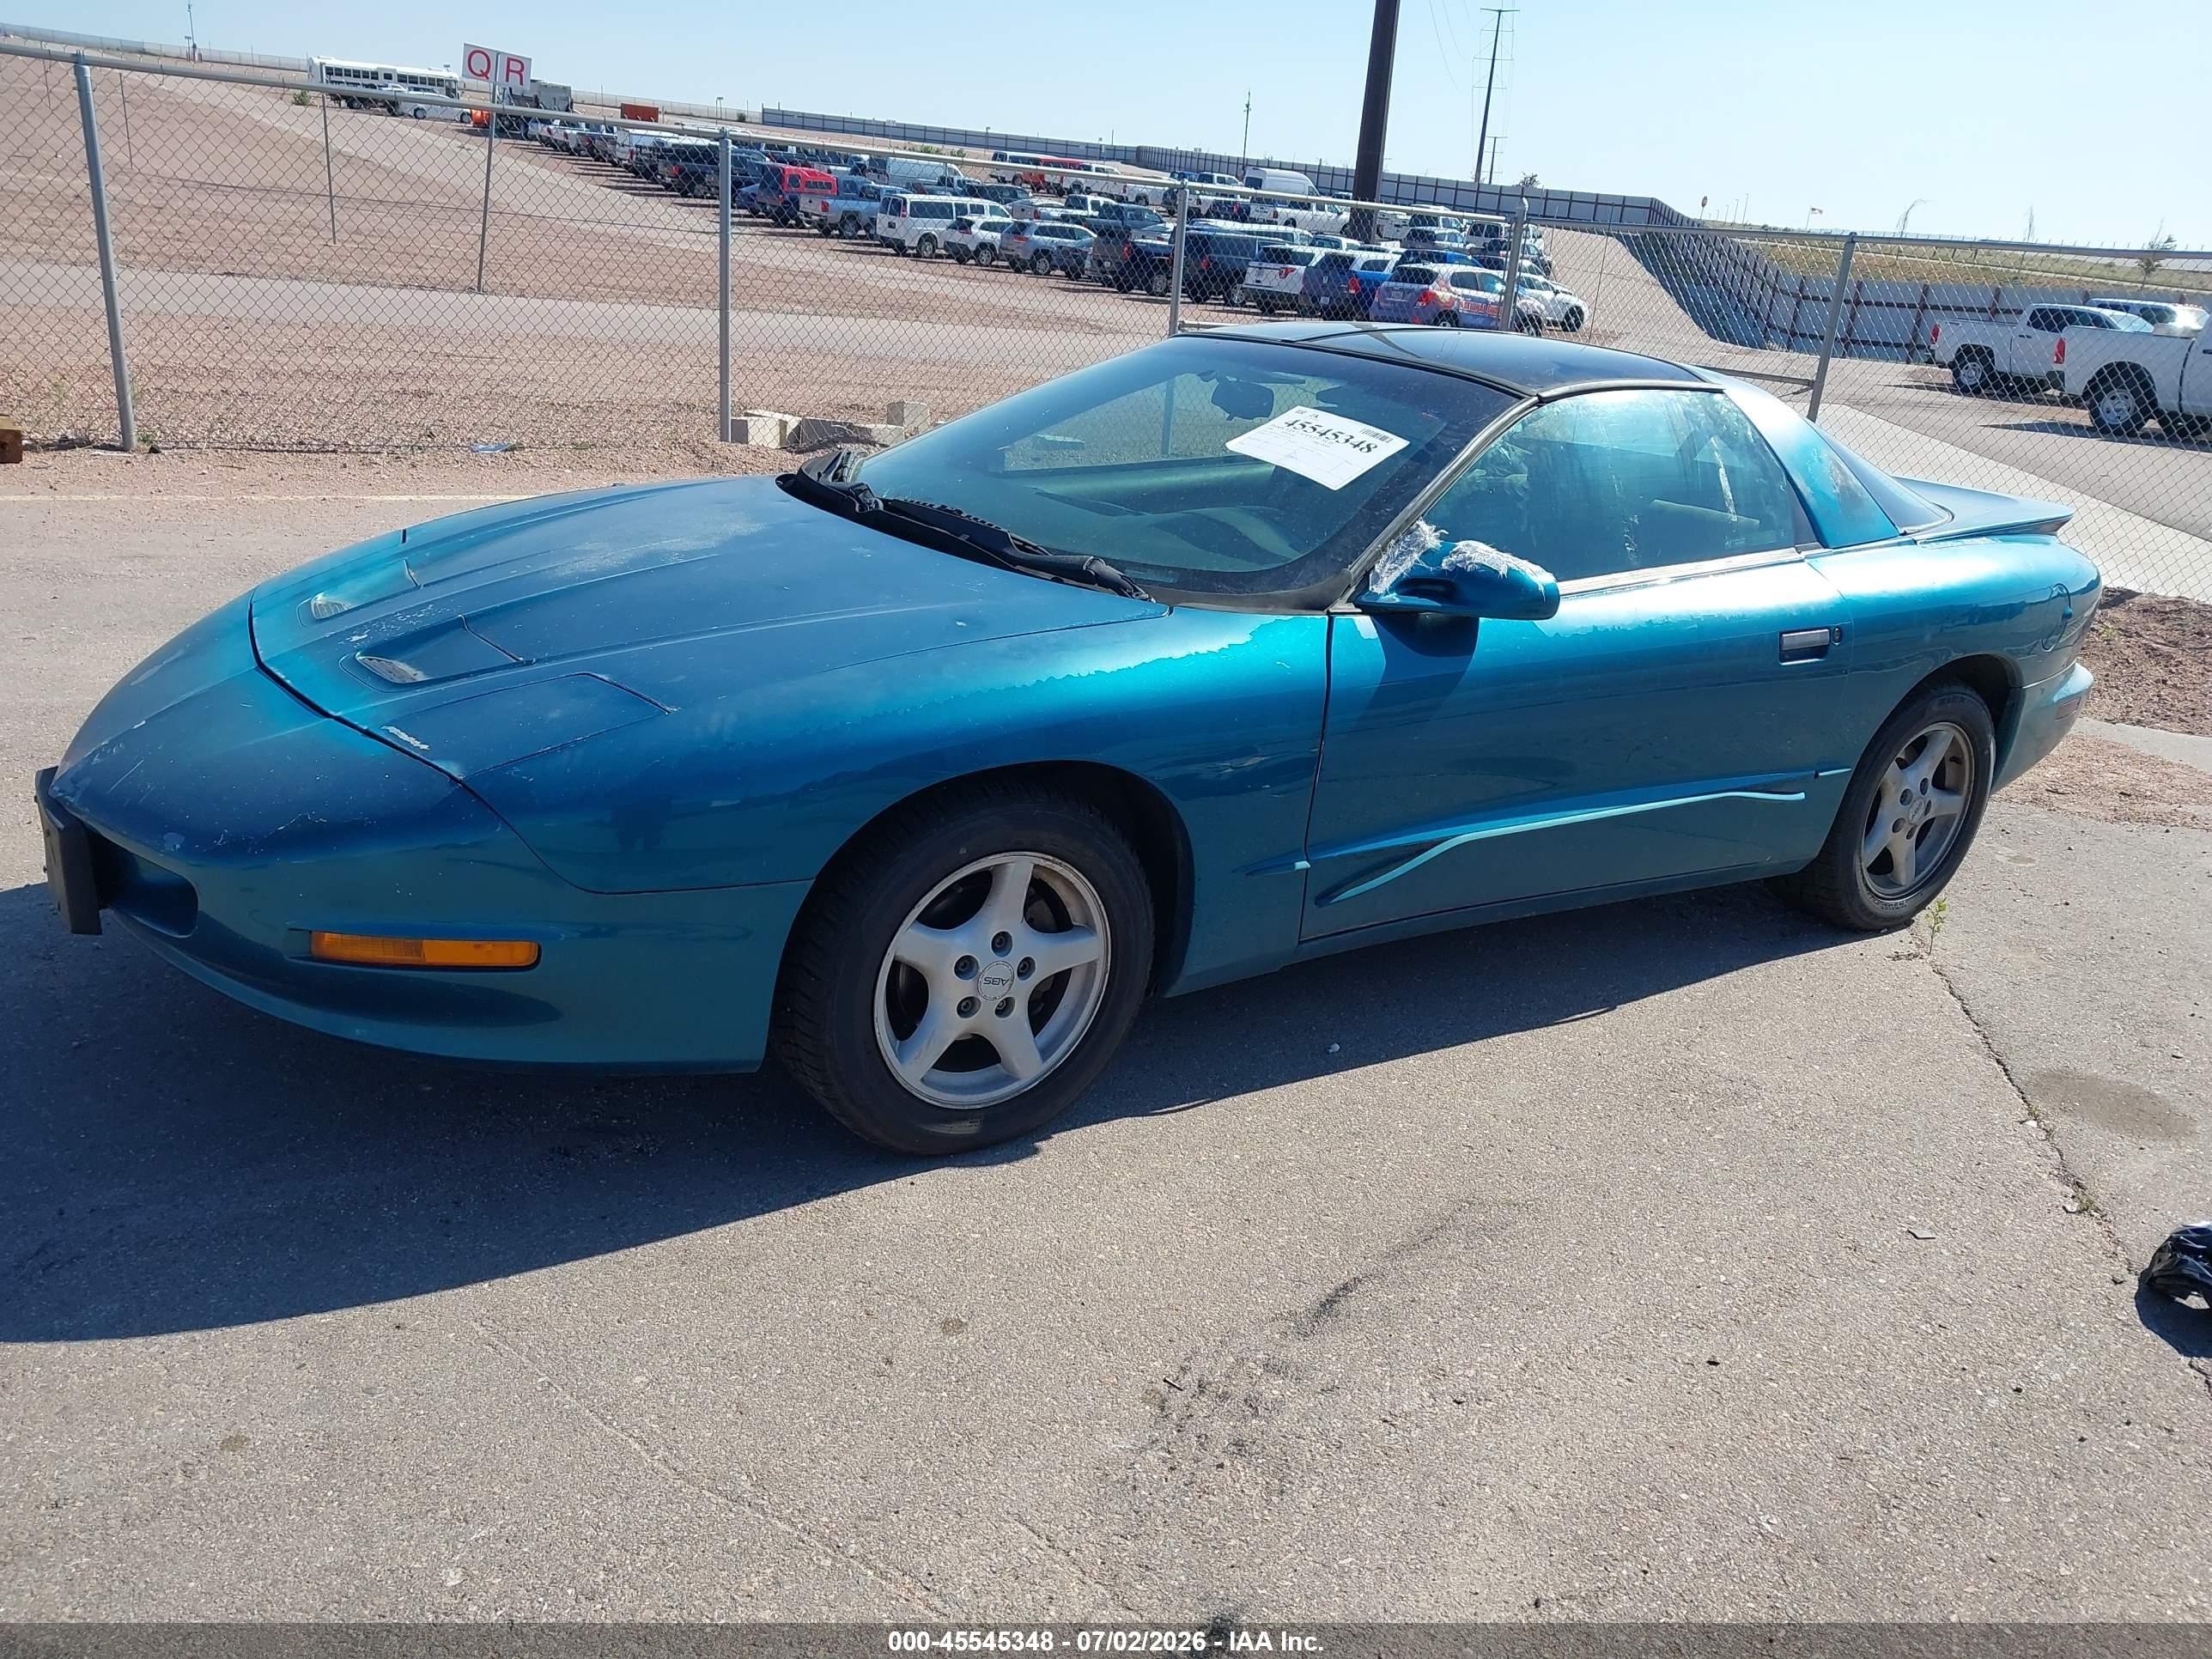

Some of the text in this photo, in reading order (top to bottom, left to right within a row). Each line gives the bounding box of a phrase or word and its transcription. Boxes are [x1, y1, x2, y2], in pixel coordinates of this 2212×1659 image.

[467, 49, 525, 86] Q R
[1284, 418, 1378, 453] 45545348
[983, 976, 1010, 986] ABS
